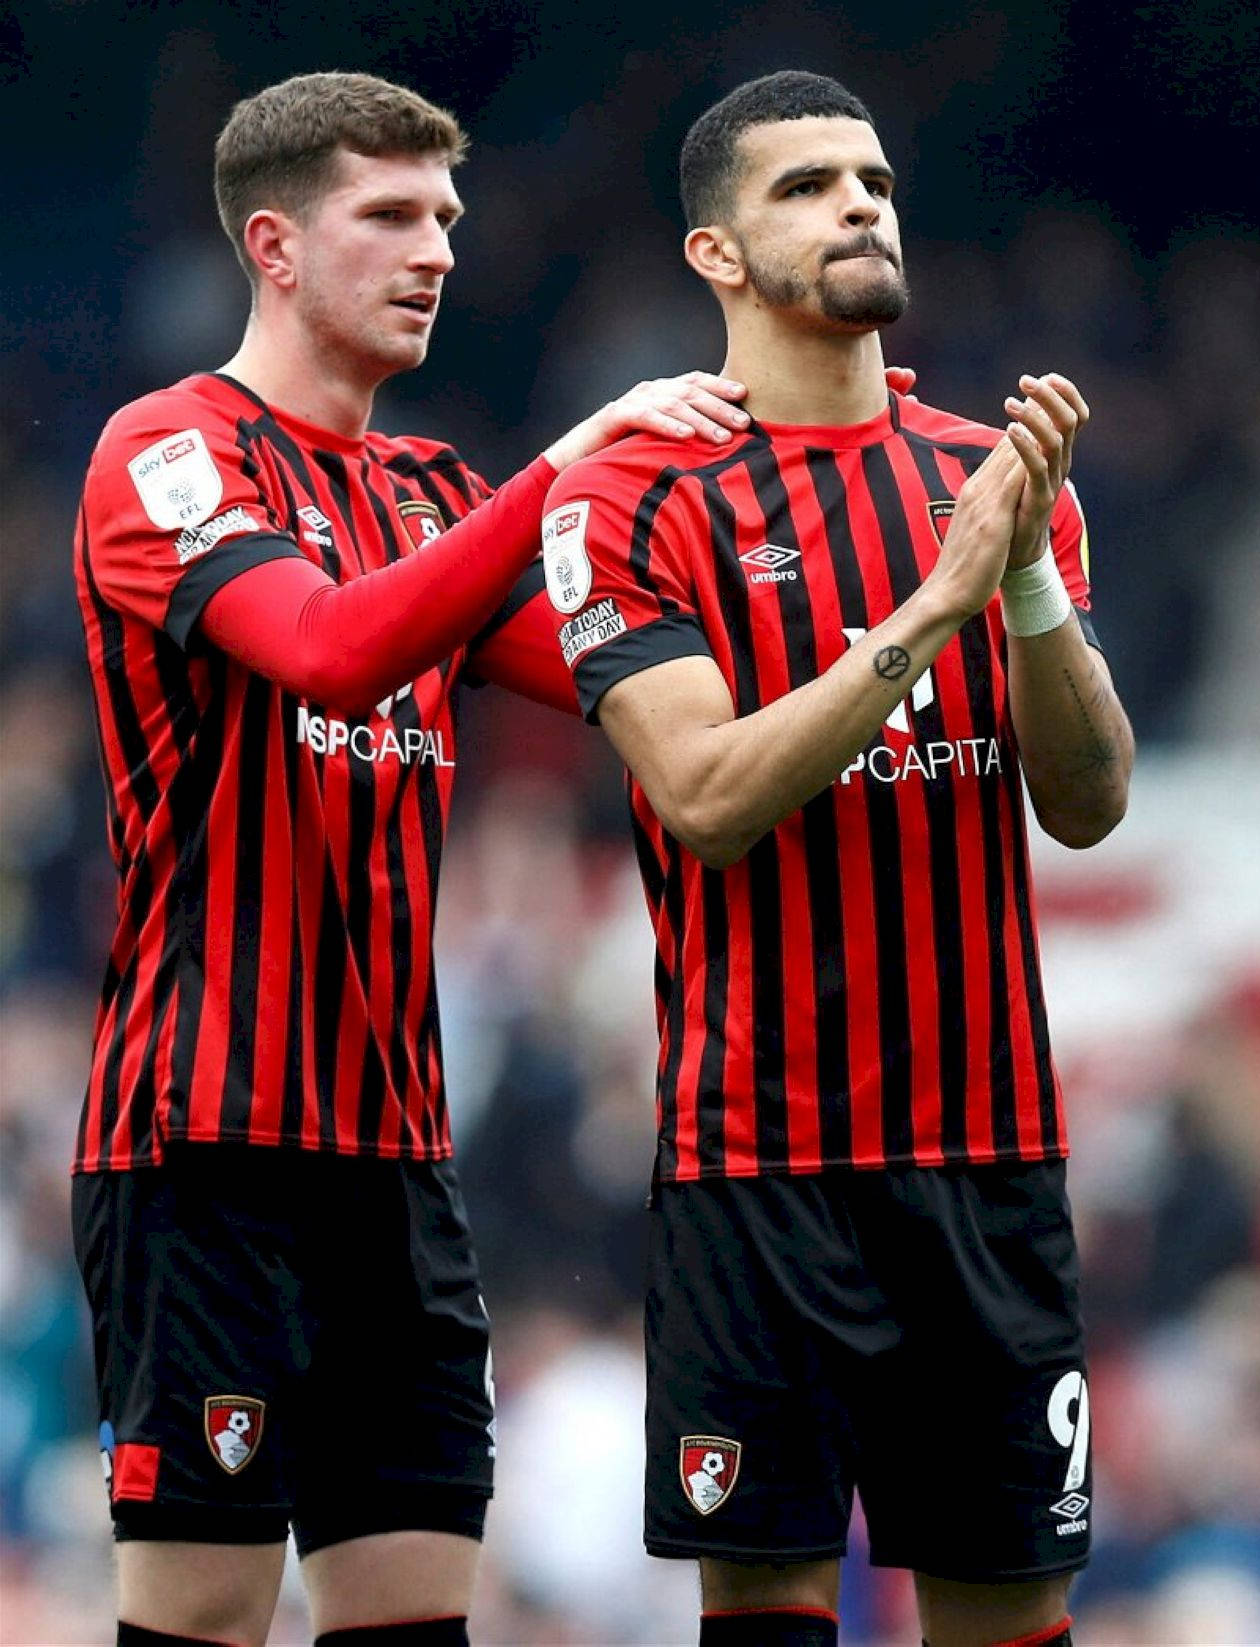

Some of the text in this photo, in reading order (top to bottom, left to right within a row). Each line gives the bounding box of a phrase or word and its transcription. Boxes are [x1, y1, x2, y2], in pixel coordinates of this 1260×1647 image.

[751, 569, 797, 583] umbro
[563, 586, 579, 602] EFL
[574, 597, 615, 632] TODAY
[571, 628, 596, 652] ANY
[598, 615, 622, 640] DAY
[1047, 1371, 1090, 1492] 9
